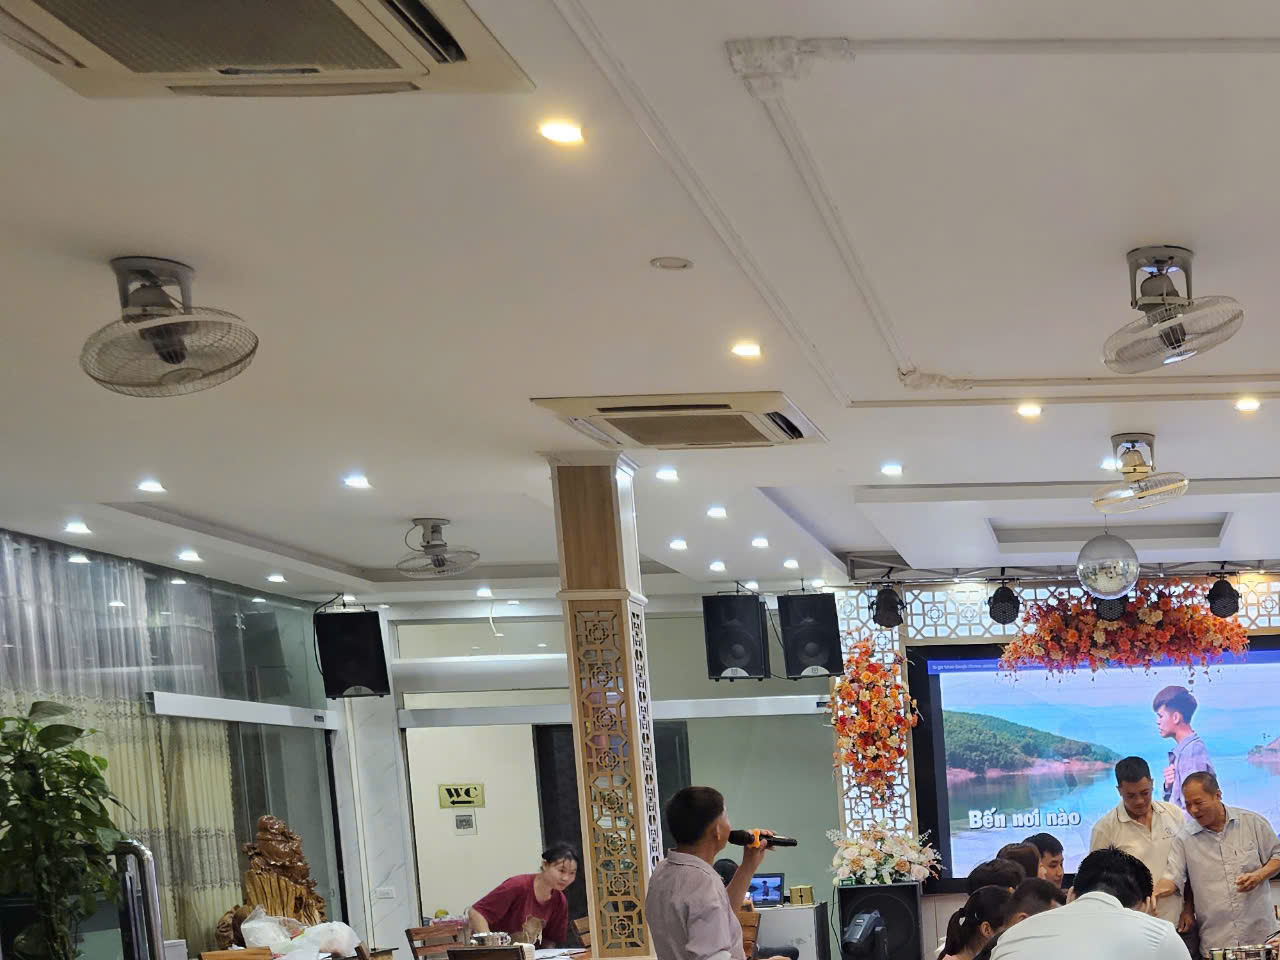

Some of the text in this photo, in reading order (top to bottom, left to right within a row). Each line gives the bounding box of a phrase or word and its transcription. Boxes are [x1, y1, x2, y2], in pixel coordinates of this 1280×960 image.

[445, 786, 479, 799] WC
[968, 807, 1081, 829] Bến nơi nào
